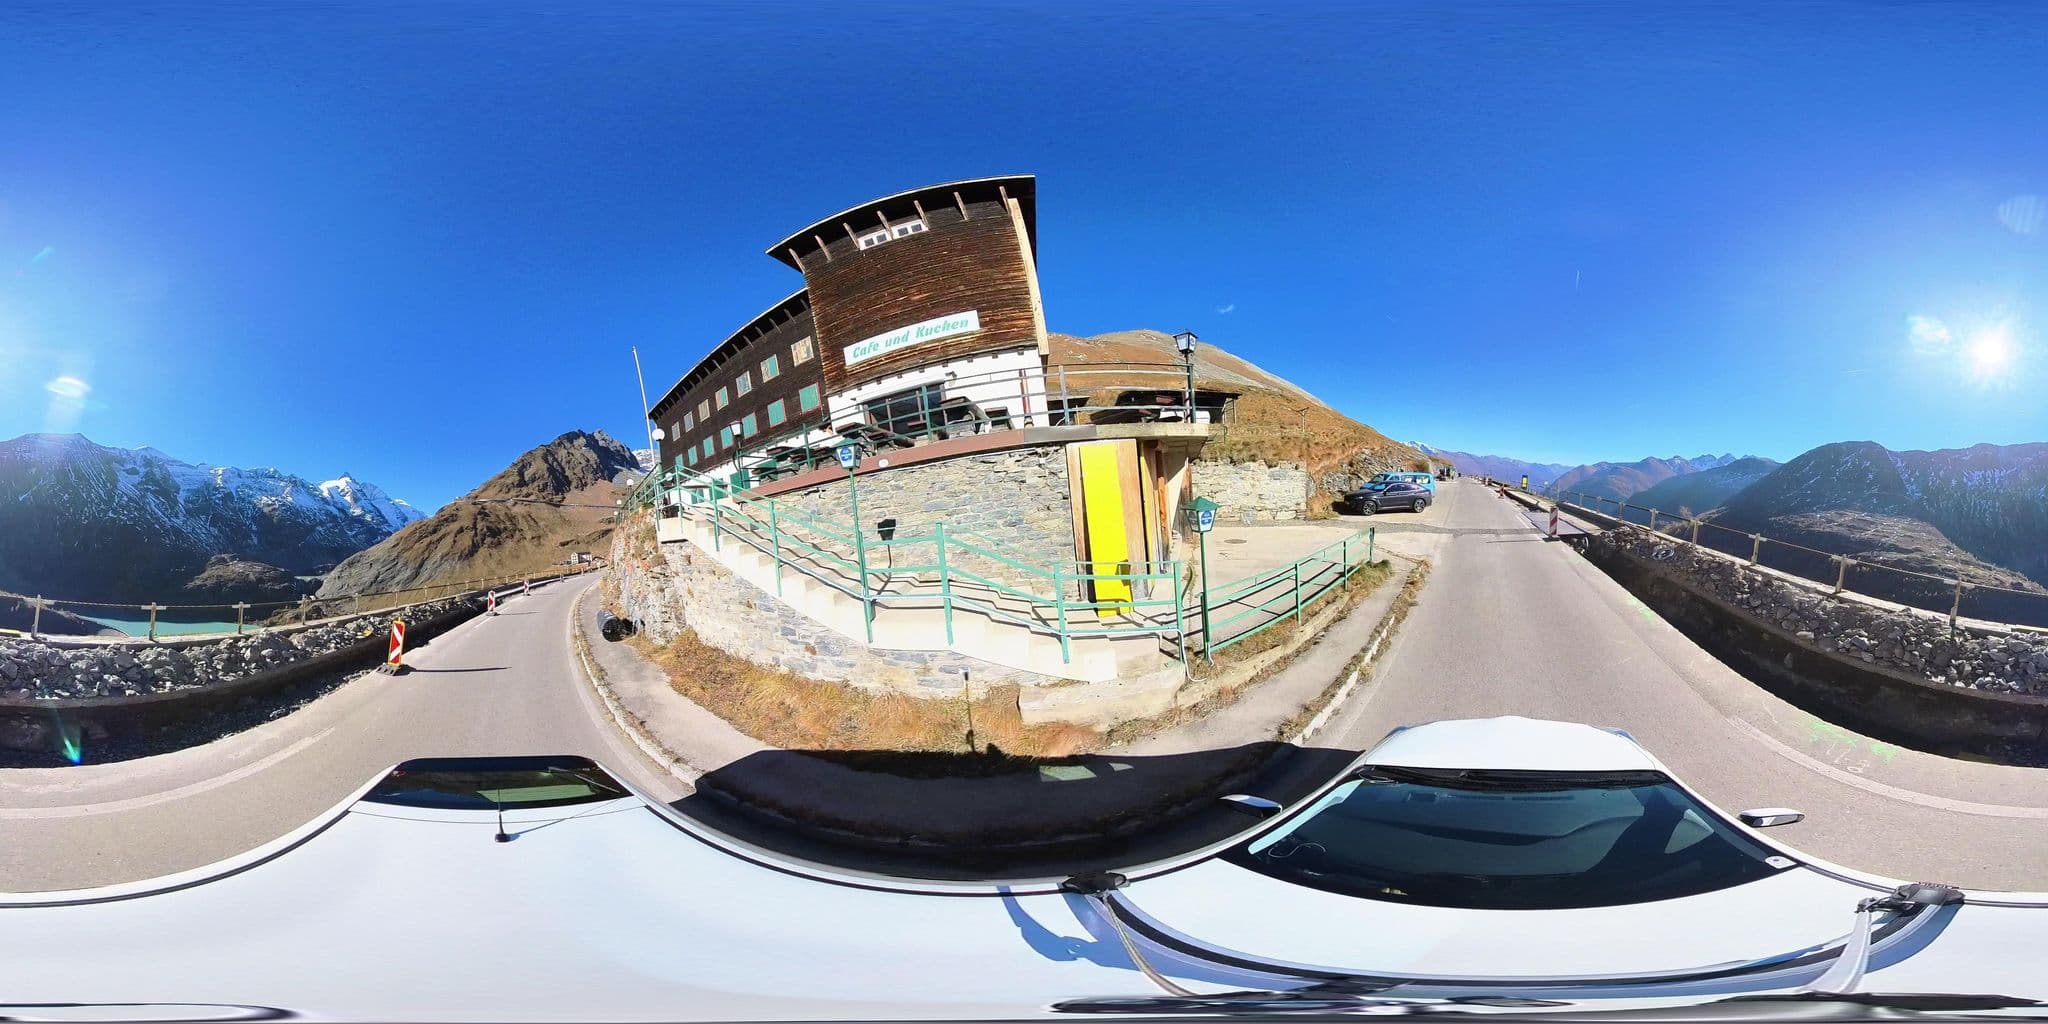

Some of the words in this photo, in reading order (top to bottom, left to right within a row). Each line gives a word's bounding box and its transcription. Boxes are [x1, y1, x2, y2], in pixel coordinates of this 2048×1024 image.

[853, 341, 879, 358] Cafe
[885, 331, 910, 347] und
[915, 319, 968, 338] Kuchen
